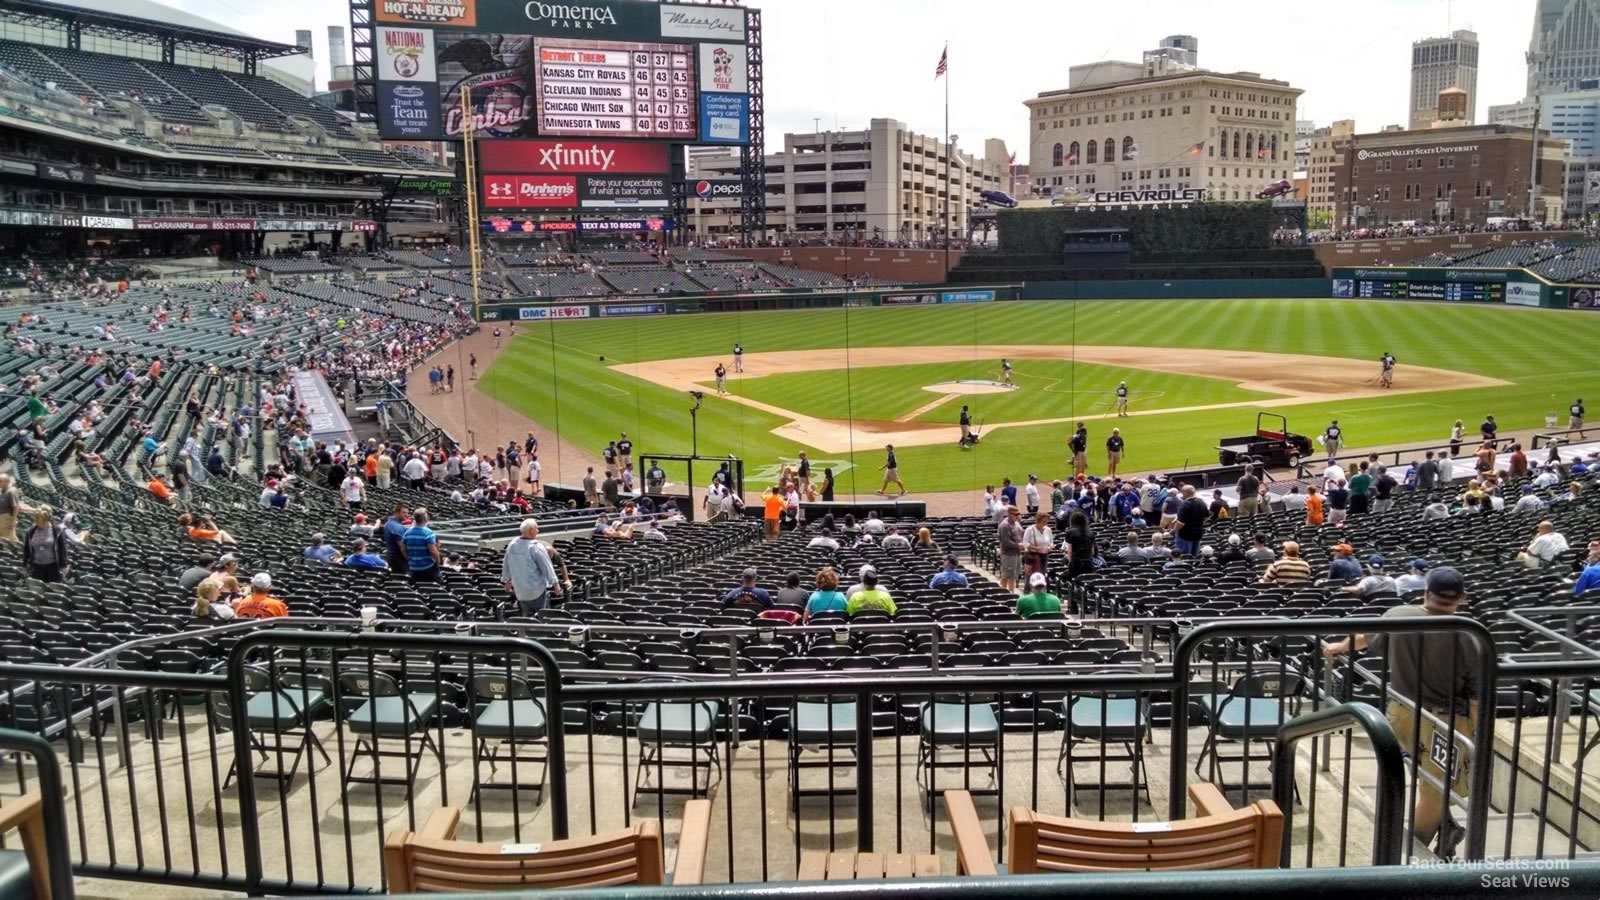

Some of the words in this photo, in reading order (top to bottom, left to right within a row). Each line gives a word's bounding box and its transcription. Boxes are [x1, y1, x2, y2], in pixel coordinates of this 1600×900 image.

[384, 2, 466, 17] HOT-N-READY
[551, 19, 593, 29] PARK
[385, 30, 424, 46] NATIONAL
[542, 50, 576, 62] DETROIT
[578, 52, 606, 64] TIGERS
[636, 54, 647, 65] 49
[655, 55, 666, 65] 37
[543, 67, 575, 79] KANSAS
[578, 68, 594, 79] CITY
[597, 69, 626, 80] ROYALS
[636, 71, 648, 81] 46
[656, 72, 667, 82] 43
[673, 72, 687, 82] 4.5
[543, 84, 587, 95] CLEVELAND
[589, 86, 622, 96] INDIANS
[637, 87, 649, 97] 44
[656, 88, 668, 98] 45
[674, 88, 688, 99] 6.5
[393, 98, 411, 106] Trust
[707, 95, 741, 103] Confidence
[391, 105, 427, 118] Team
[544, 101, 578, 112] CHICAGO
[581, 102, 605, 112] WHITE
[608, 103, 624, 113] SOX
[637, 104, 649, 114] 44
[657, 105, 668, 114] 47
[675, 105, 688, 115] 7.5
[545, 118, 592, 129] MINNESOTA
[594, 119, 621, 129] TWINS
[638, 120, 650, 130] 40
[657, 121, 669, 130] 49
[675, 121, 690, 130] 10.5
[402, 127, 421, 135] yours
[1367, 150, 1391, 158] GRAND
[1415, 147, 1436, 155] STATE
[1435, 144, 1479, 153] UNIVERSITY
[539, 143, 612, 170] xfinity
[429, 180, 451, 190] Green
[521, 182, 574, 194] Dunham's
[587, 178, 606, 186] Raise
[623, 179, 663, 188] expectations
[589, 187, 596, 195] of
[598, 187, 614, 195] what
[621, 187, 638, 195] bank
[713, 184, 743, 195] pepsi
[1095, 188, 1206, 203] CHEVROLET
[1075, 203, 1189, 213] FOUNTAIN
[582, 222, 598, 230] TEXT
[600, 222, 608, 230] A3
[610, 222, 619, 230] TO
[1491, 233, 1502, 242] 42
[522, 309, 546, 317] DMC
